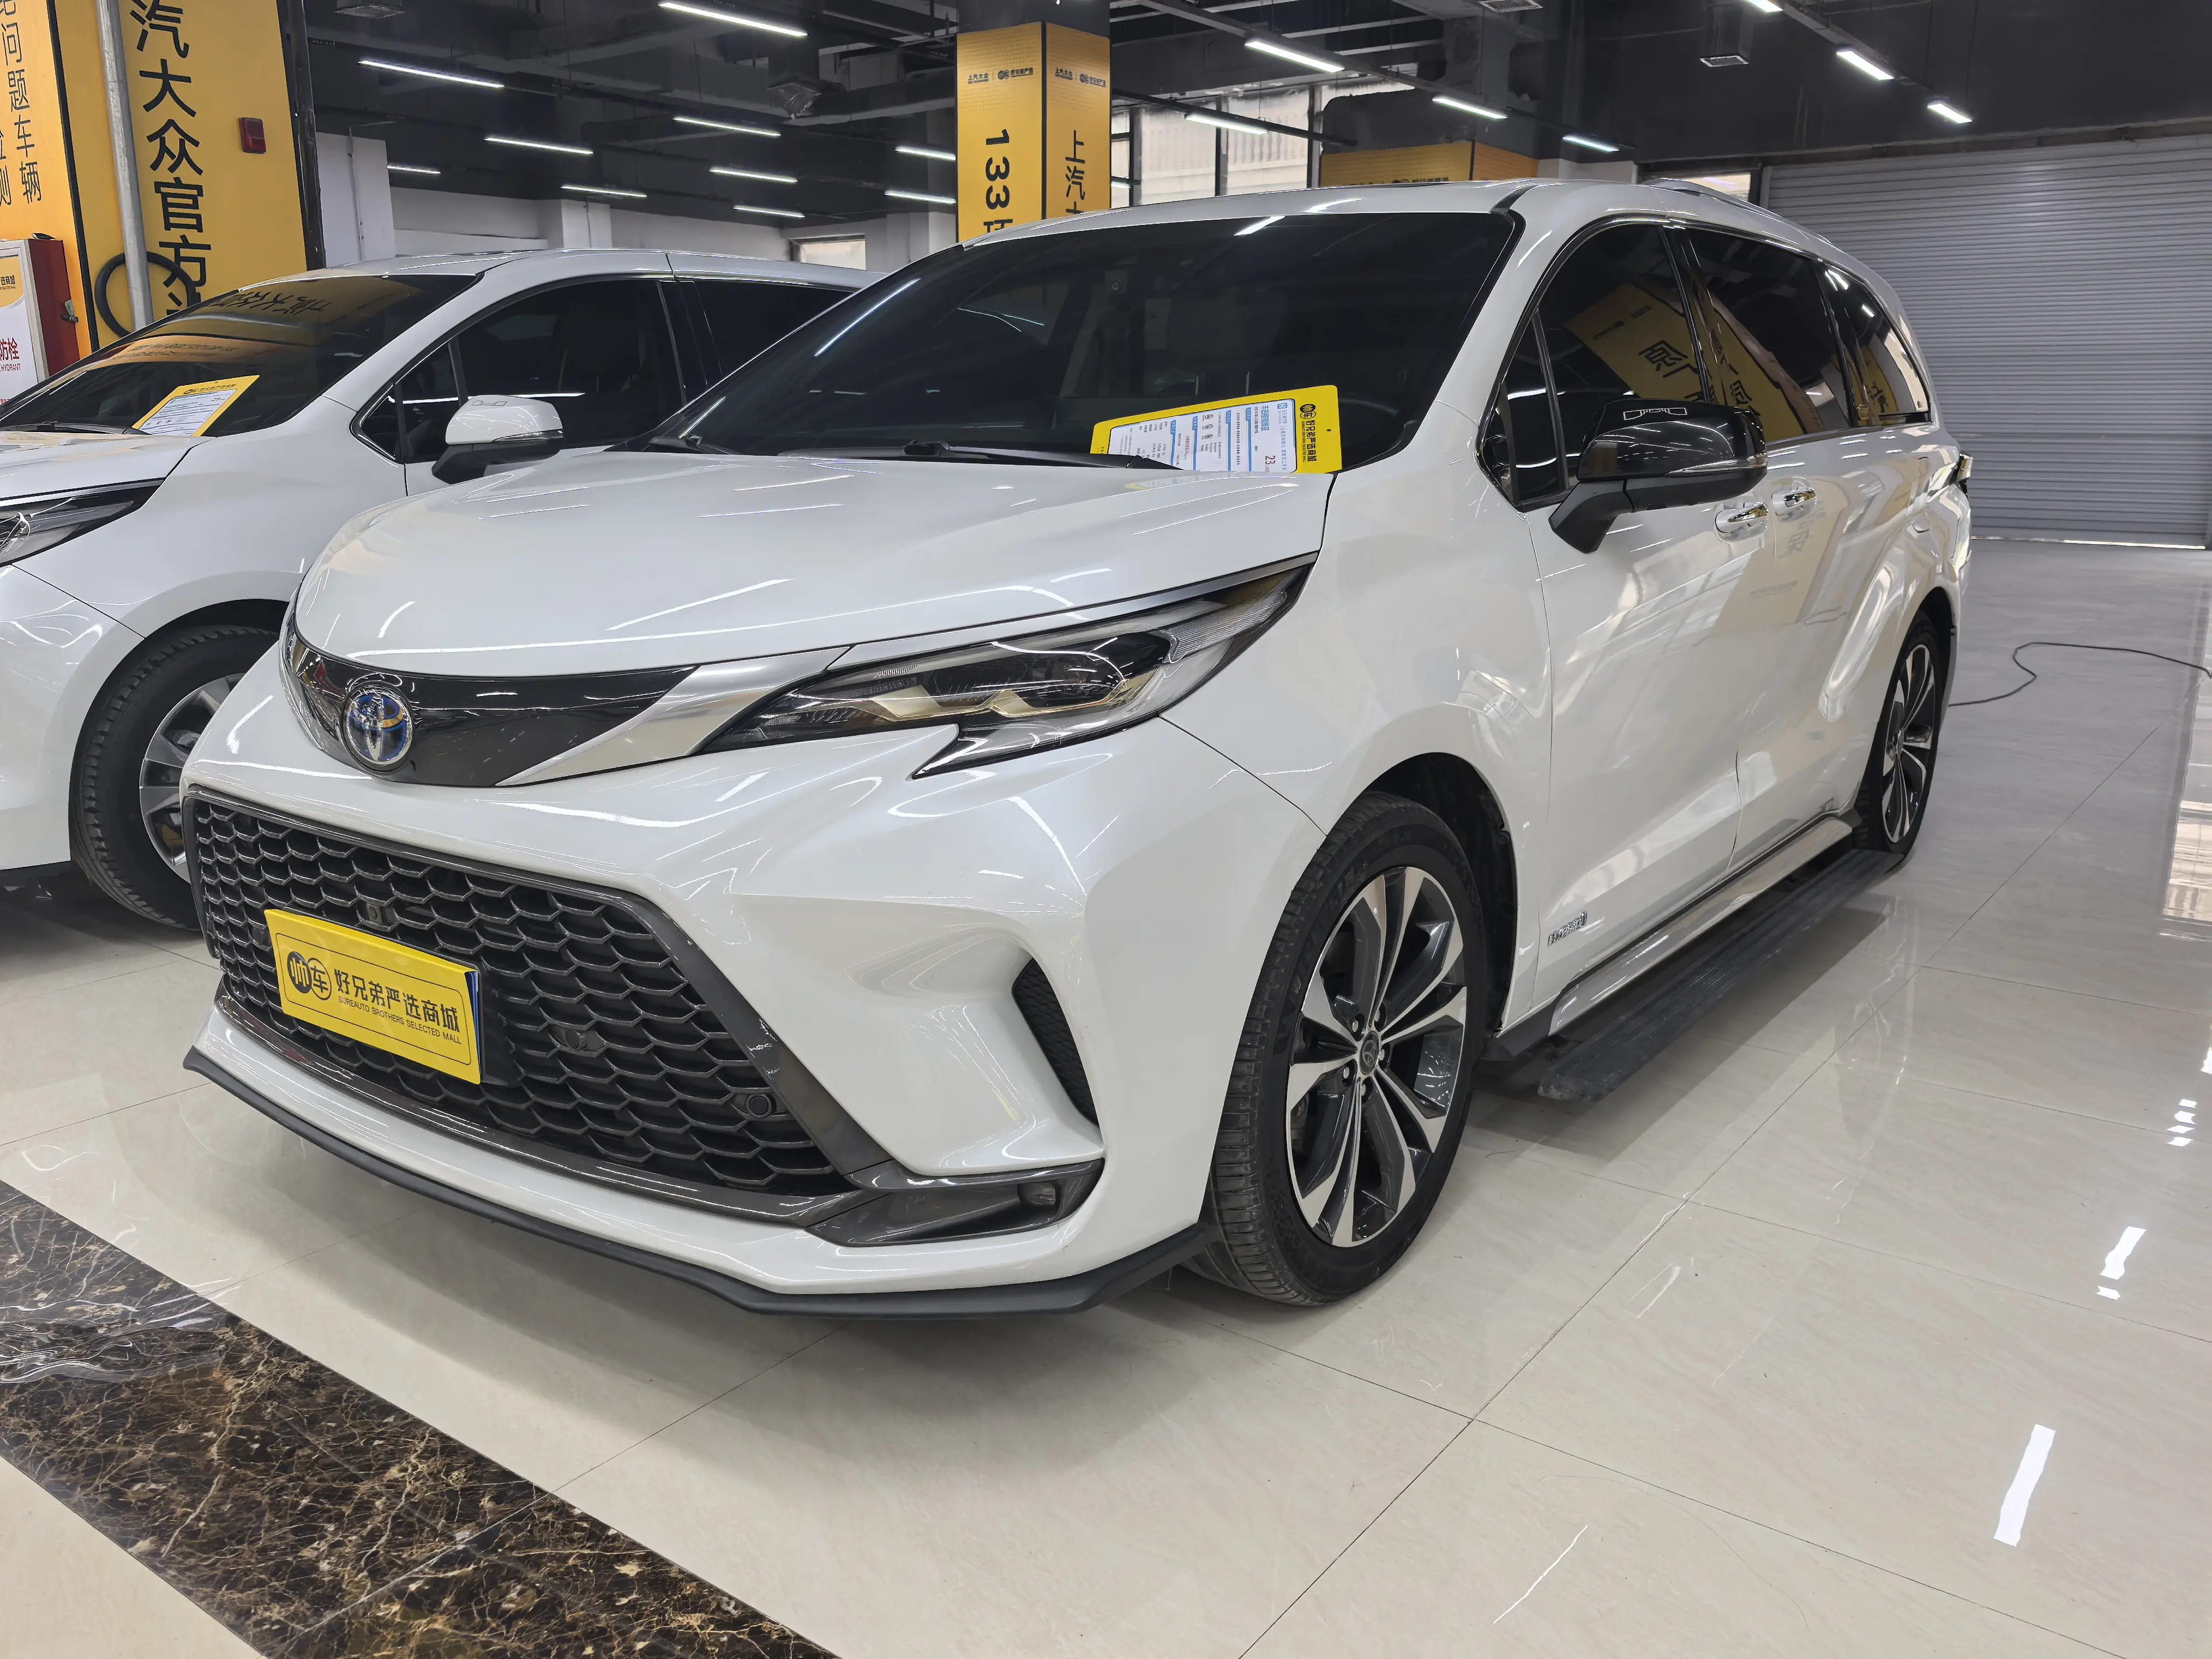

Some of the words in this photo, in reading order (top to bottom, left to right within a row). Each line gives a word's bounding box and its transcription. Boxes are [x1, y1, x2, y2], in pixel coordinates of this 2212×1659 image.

[0, 0, 41, 204] 问题车辆
[130, 0, 211, 315] 汽大众官方
[983, 129, 1013, 233] 133
[1265, 455, 1276, 465] 23
[334, 968, 460, 1033] 好兄弟严选商城
[338, 995, 370, 1013] SUREAUTO
[372, 1006, 404, 1025] BROTHERS
[407, 1019, 441, 1037] SELECTED
[443, 1031, 462, 1044] MALL
